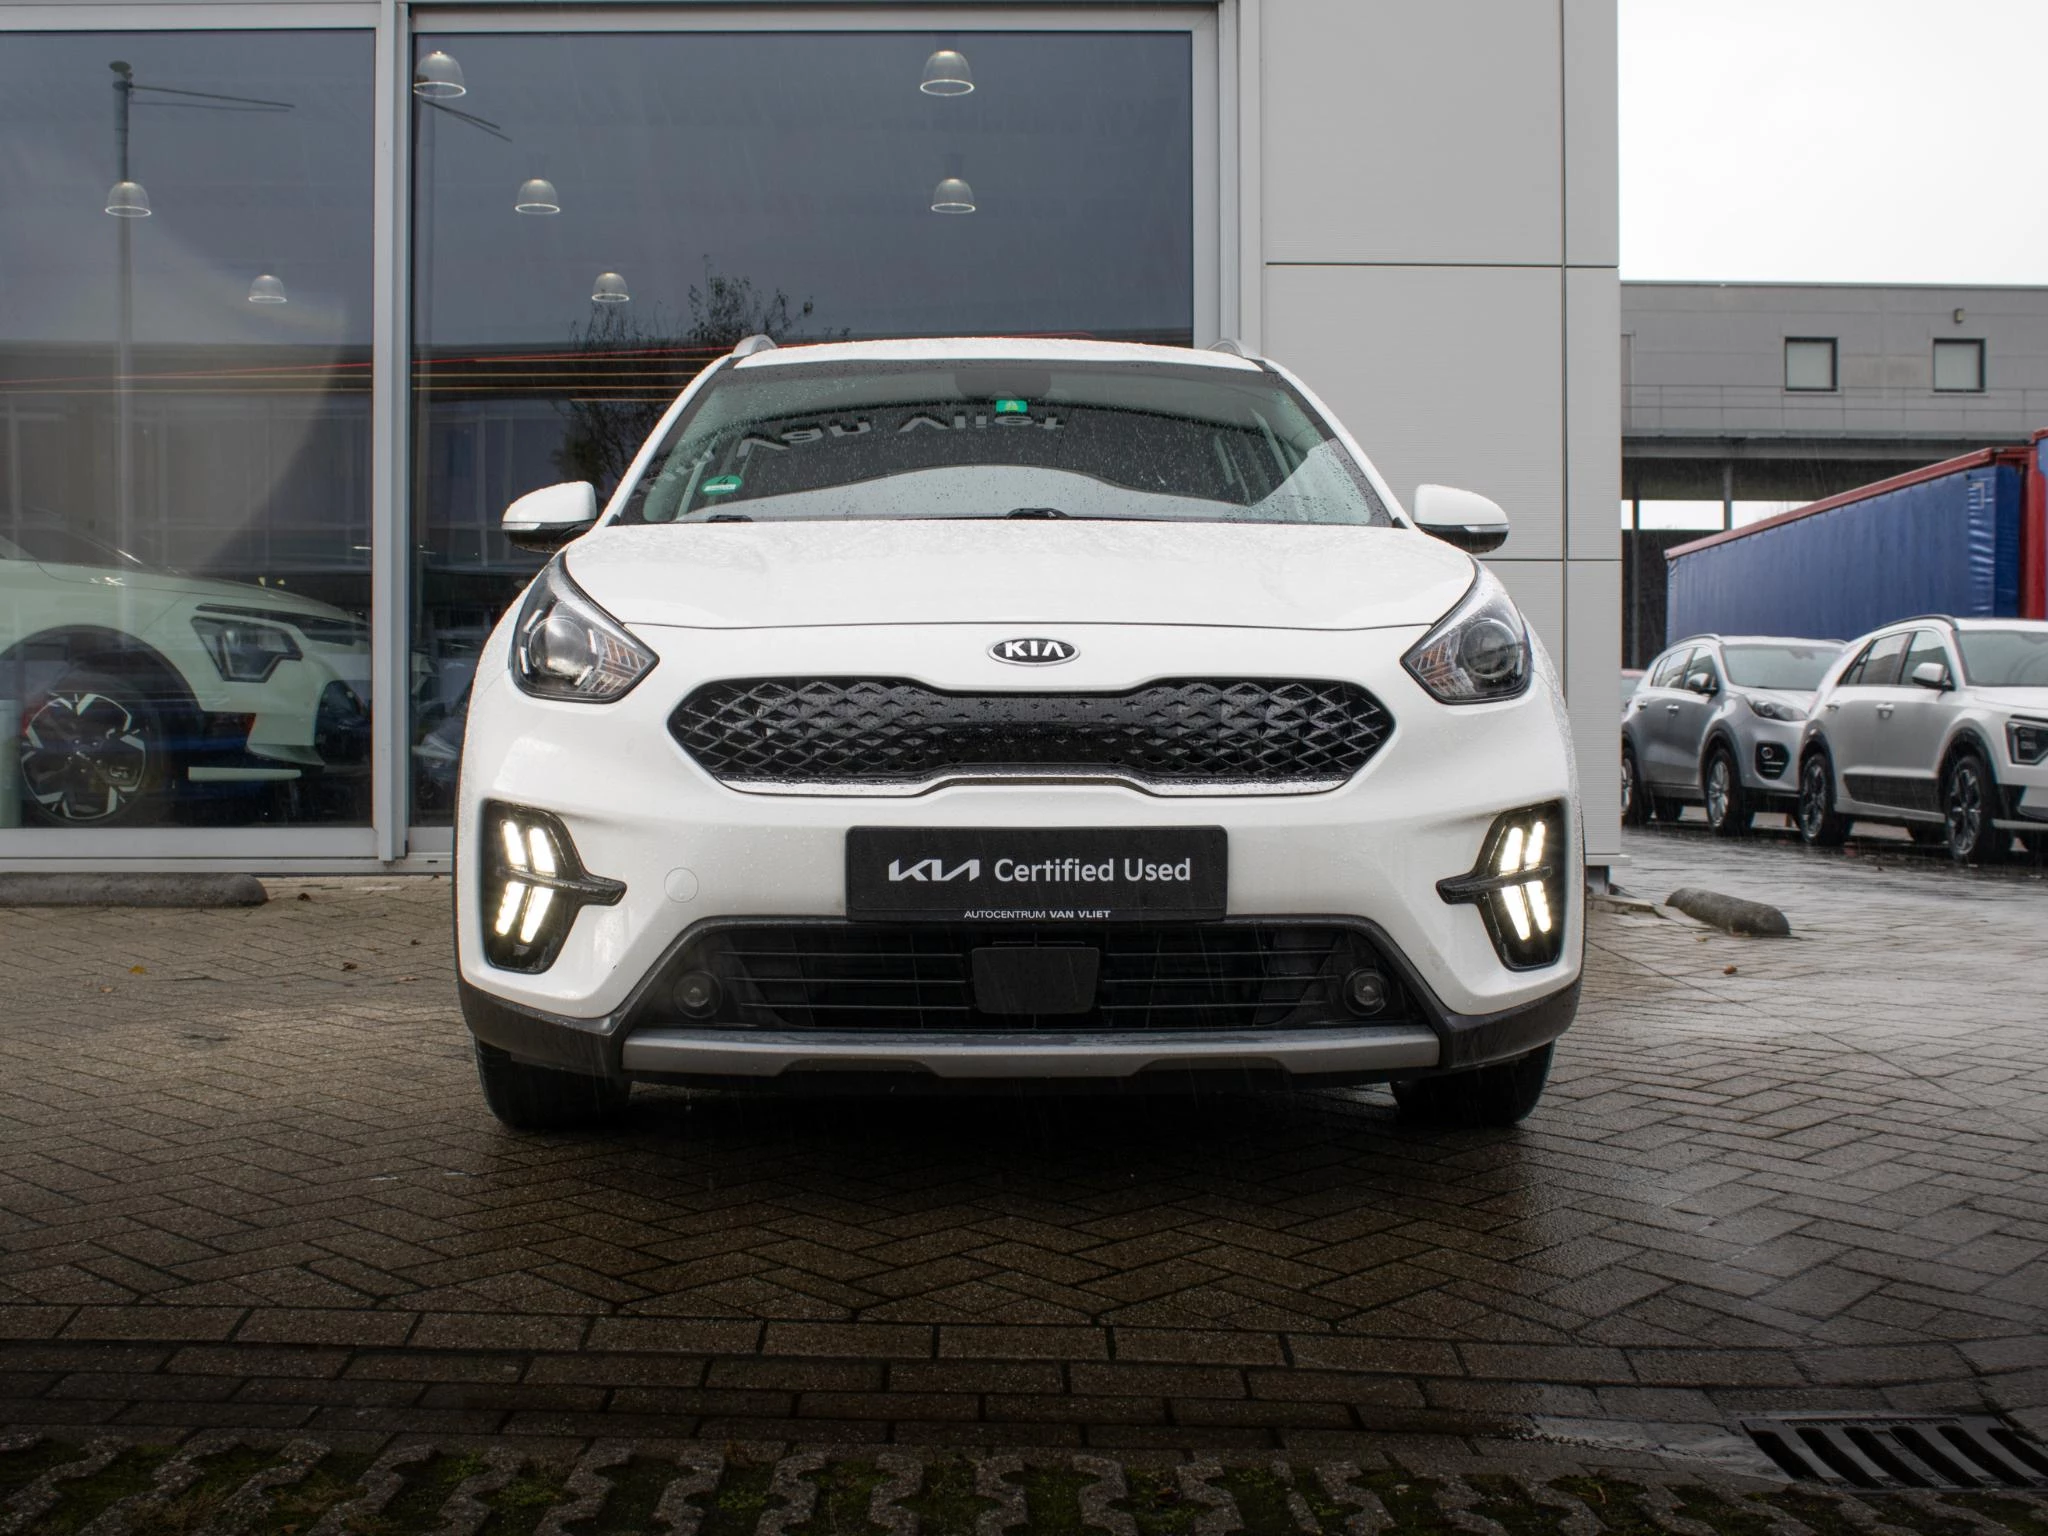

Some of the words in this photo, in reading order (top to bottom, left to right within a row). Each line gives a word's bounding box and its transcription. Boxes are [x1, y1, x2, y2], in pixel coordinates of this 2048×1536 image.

[1004, 640, 1065, 658] KIA
[994, 857, 1115, 882] Certified
[1124, 858, 1191, 882] Used
[964, 909, 1046, 919] AUTOCENTRUM
[1049, 909, 1076, 919] VAN
[1077, 909, 1111, 919] VLIET
